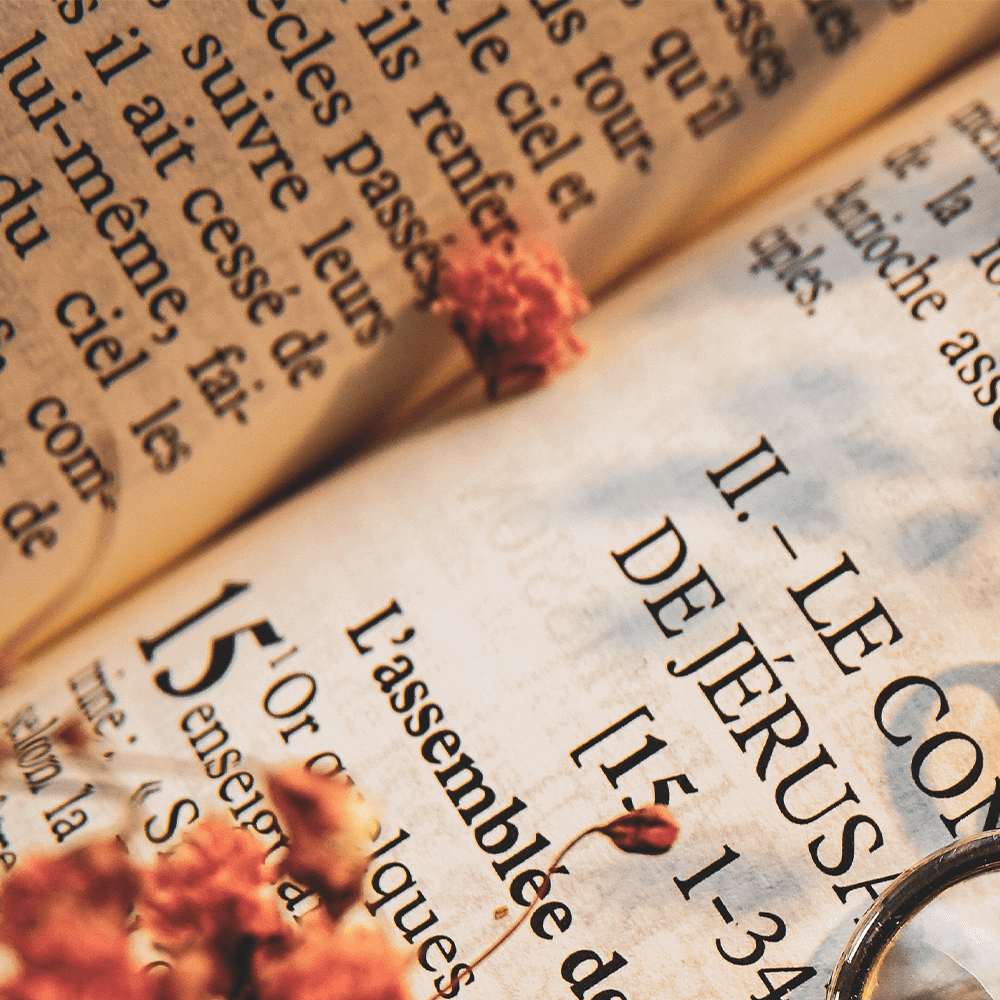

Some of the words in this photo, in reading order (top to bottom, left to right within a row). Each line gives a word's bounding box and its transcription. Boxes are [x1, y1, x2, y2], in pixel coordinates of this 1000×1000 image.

[181, 33, 309, 211] suivre
[300, 218, 412, 346] leurs
[357, 0, 422, 81] ils
[408, 93, 520, 255] renfer-
[455, 4, 509, 74] le
[495, 81, 582, 173] ciel
[547, 174, 596, 222] et
[574, 54, 654, 173] tour-
[925, 176, 975, 227] la
[0, 29, 187, 344] lui-même,
[186, 344, 264, 424] fai-
[84, 26, 152, 87] il
[122, 94, 195, 180] ait
[181, 187, 299, 325] cessé
[270, 331, 328, 388] de
[26, 396, 116, 510] com-
[55, 291, 150, 389] ciel
[129, 397, 190, 472] les
[0, 501, 59, 558] de
[610, 516, 726, 639] DE
[706, 436, 790, 523] II.
[786, 551, 904, 676] LE
[138, 582, 283, 698] 15
[263, 672, 320, 744] Or
[44, 782, 96, 844] la
[346, 600, 573, 941] L'assemblée
